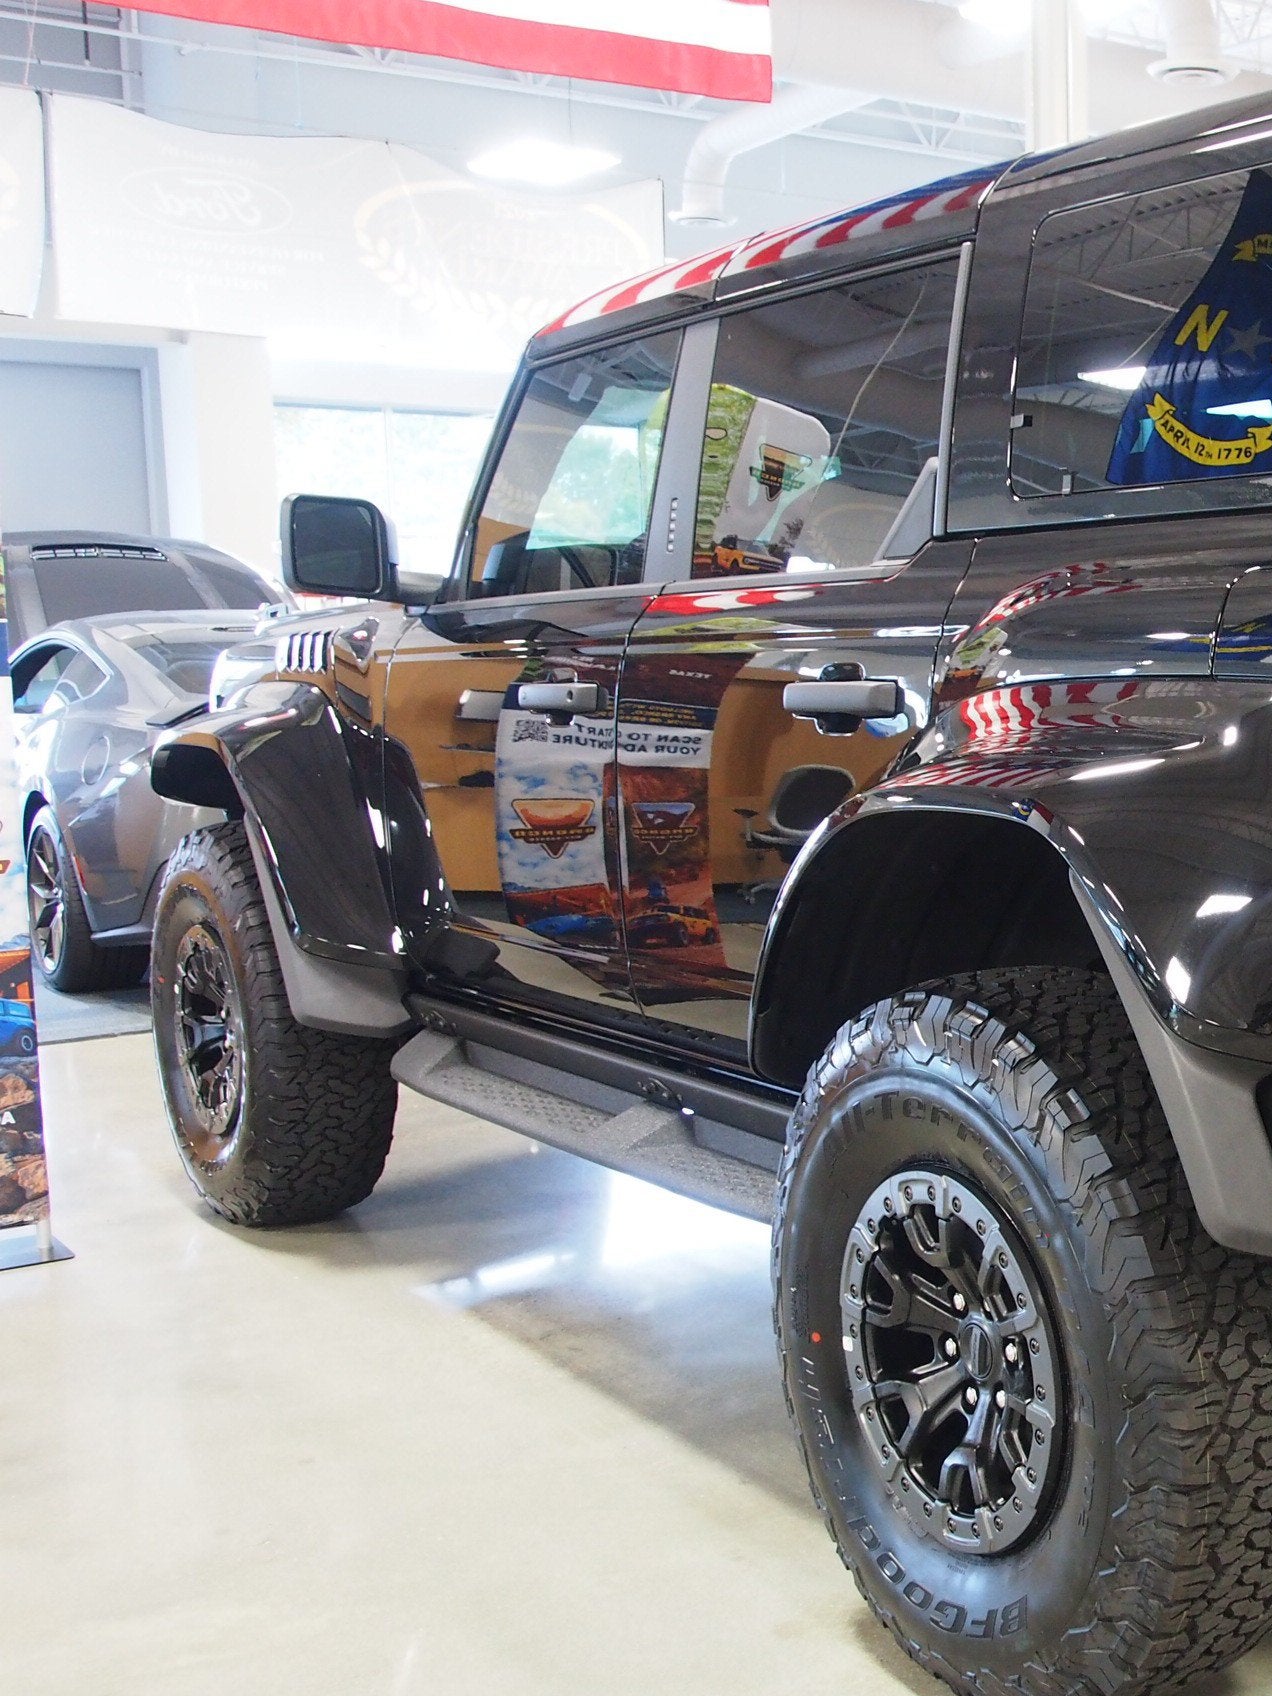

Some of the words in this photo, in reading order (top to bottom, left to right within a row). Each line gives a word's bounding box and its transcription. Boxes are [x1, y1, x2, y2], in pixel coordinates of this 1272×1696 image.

[1174, 304, 1230, 352] N
[1217, 446, 1253, 460] 1776
[0, 1111, 16, 1126] A
